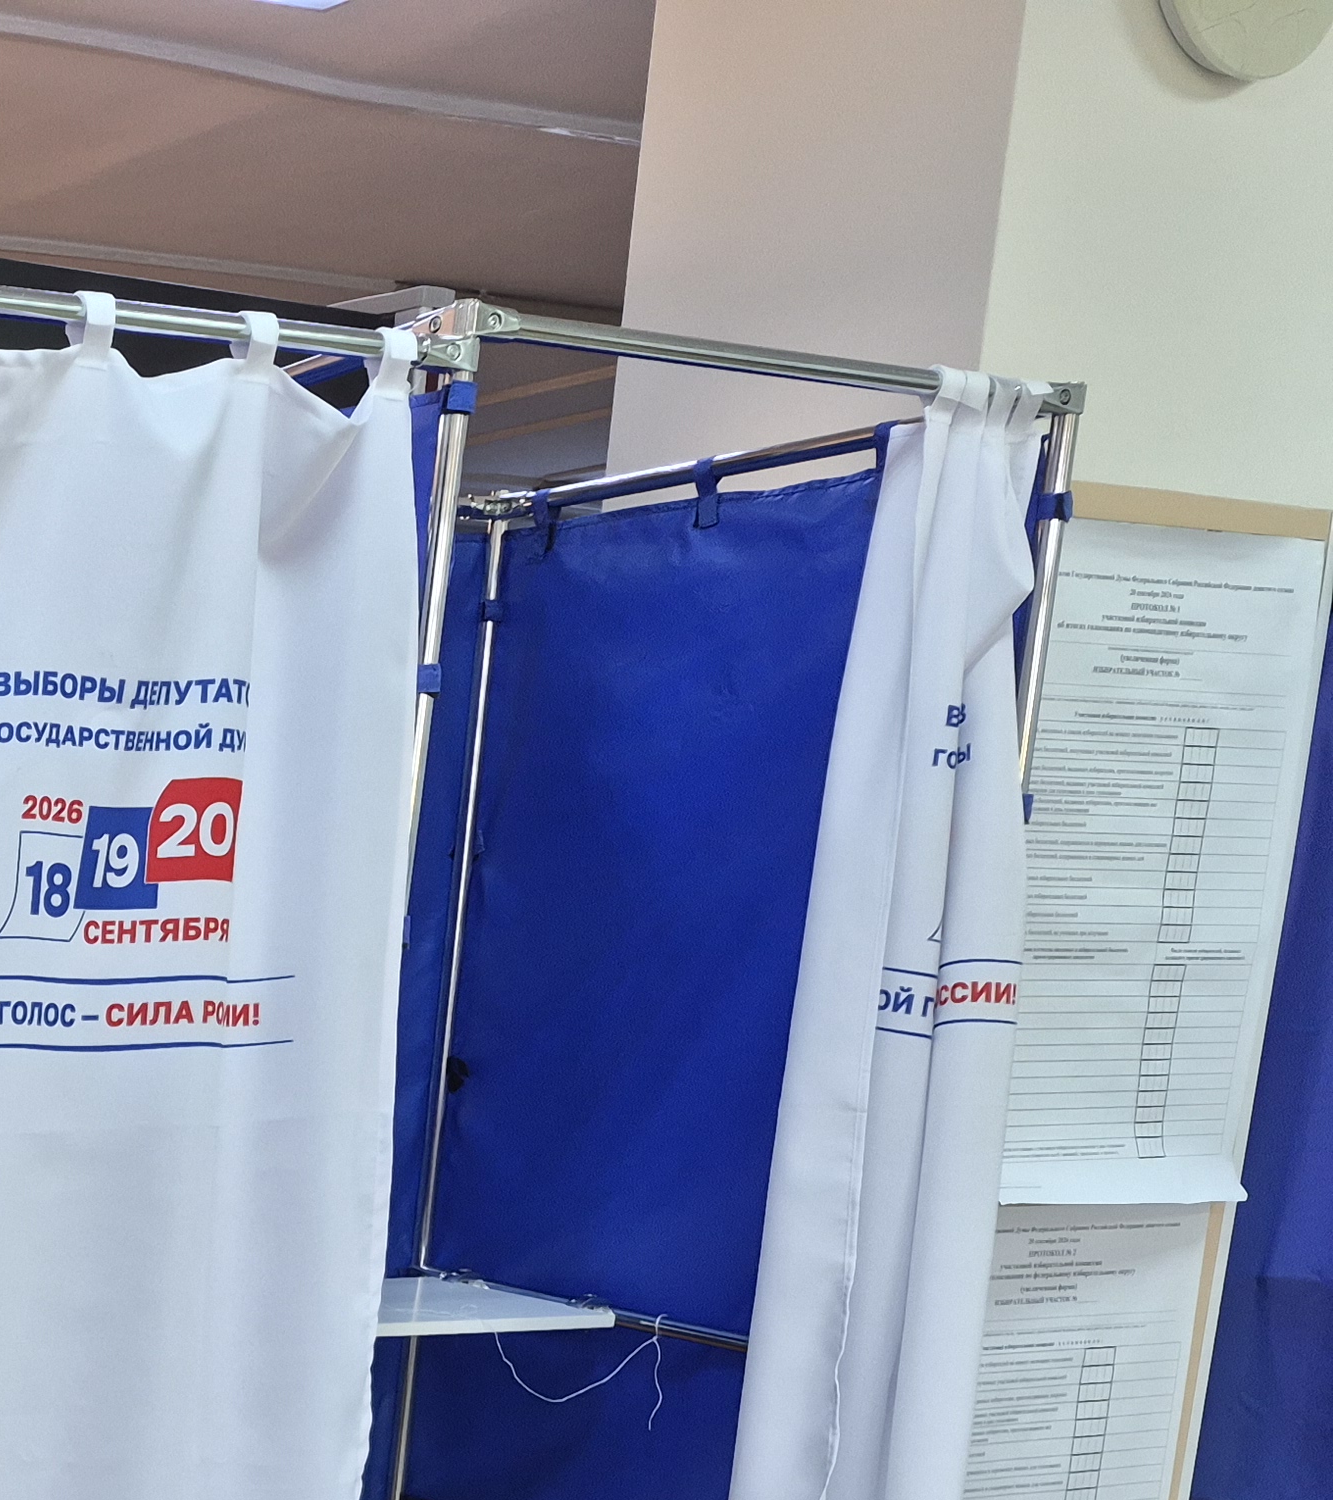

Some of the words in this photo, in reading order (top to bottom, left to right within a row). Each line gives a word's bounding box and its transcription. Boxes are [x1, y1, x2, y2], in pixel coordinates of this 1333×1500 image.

[218, 728, 246, 752] ДУ
[21, 794, 83, 824] 2026
[26, 861, 72, 918] 18
[92, 833, 139, 888] 19
[157, 802, 234, 858] 20
[84, 917, 229, 944] СЕНТЯБРЯ
[935, 981, 1017, 1009] ССИИ!
[105, 1001, 194, 1028] СИЛА
